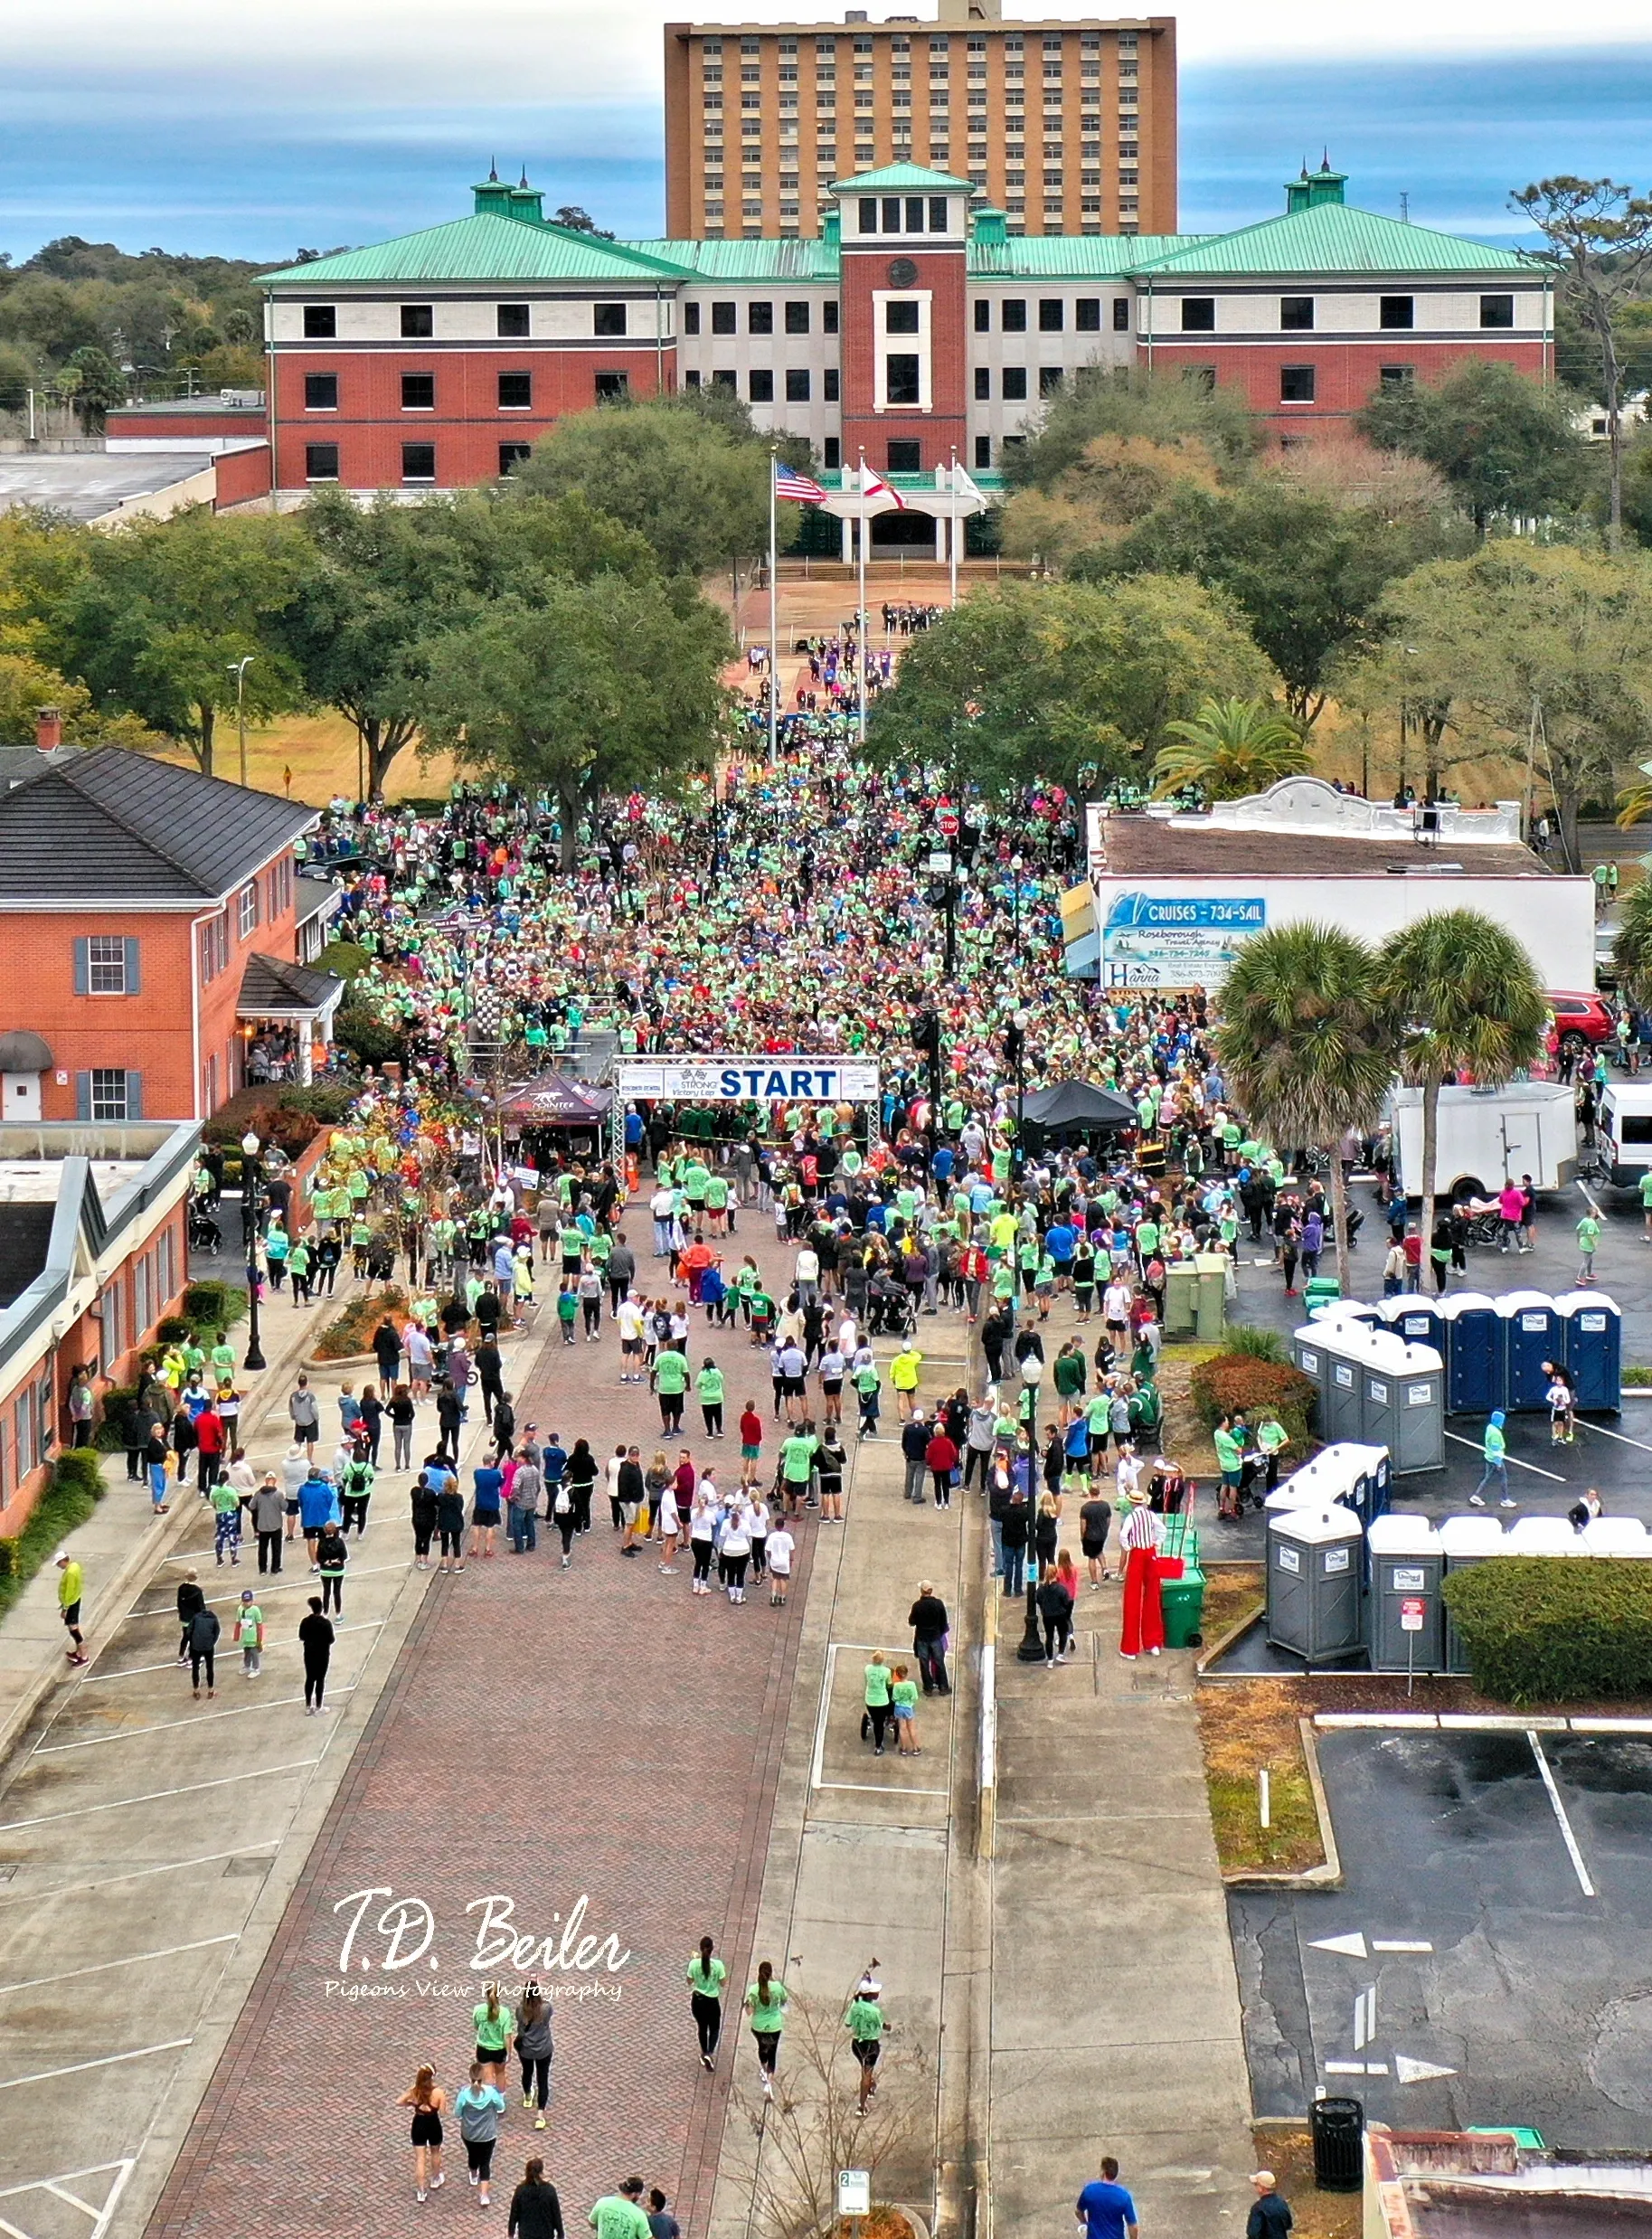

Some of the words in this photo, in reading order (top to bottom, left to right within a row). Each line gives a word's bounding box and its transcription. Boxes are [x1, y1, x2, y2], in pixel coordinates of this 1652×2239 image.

[939, 821, 957, 829] STOP
[1148, 905, 1196, 921] CRUISES
[1210, 905, 1262, 921] 734-SAIL
[1138, 930, 1204, 941] Roseborough
[1165, 939, 1190, 947] Travel
[1193, 939, 1221, 948] Agency
[1109, 963, 1161, 987] Hanna
[681, 1081, 717, 1090] STRONG
[720, 1070, 836, 1097] START
[672, 1089, 699, 1097] Victory
[701, 1089, 715, 1097] Lap
[841, 2173, 848, 2187] 2
